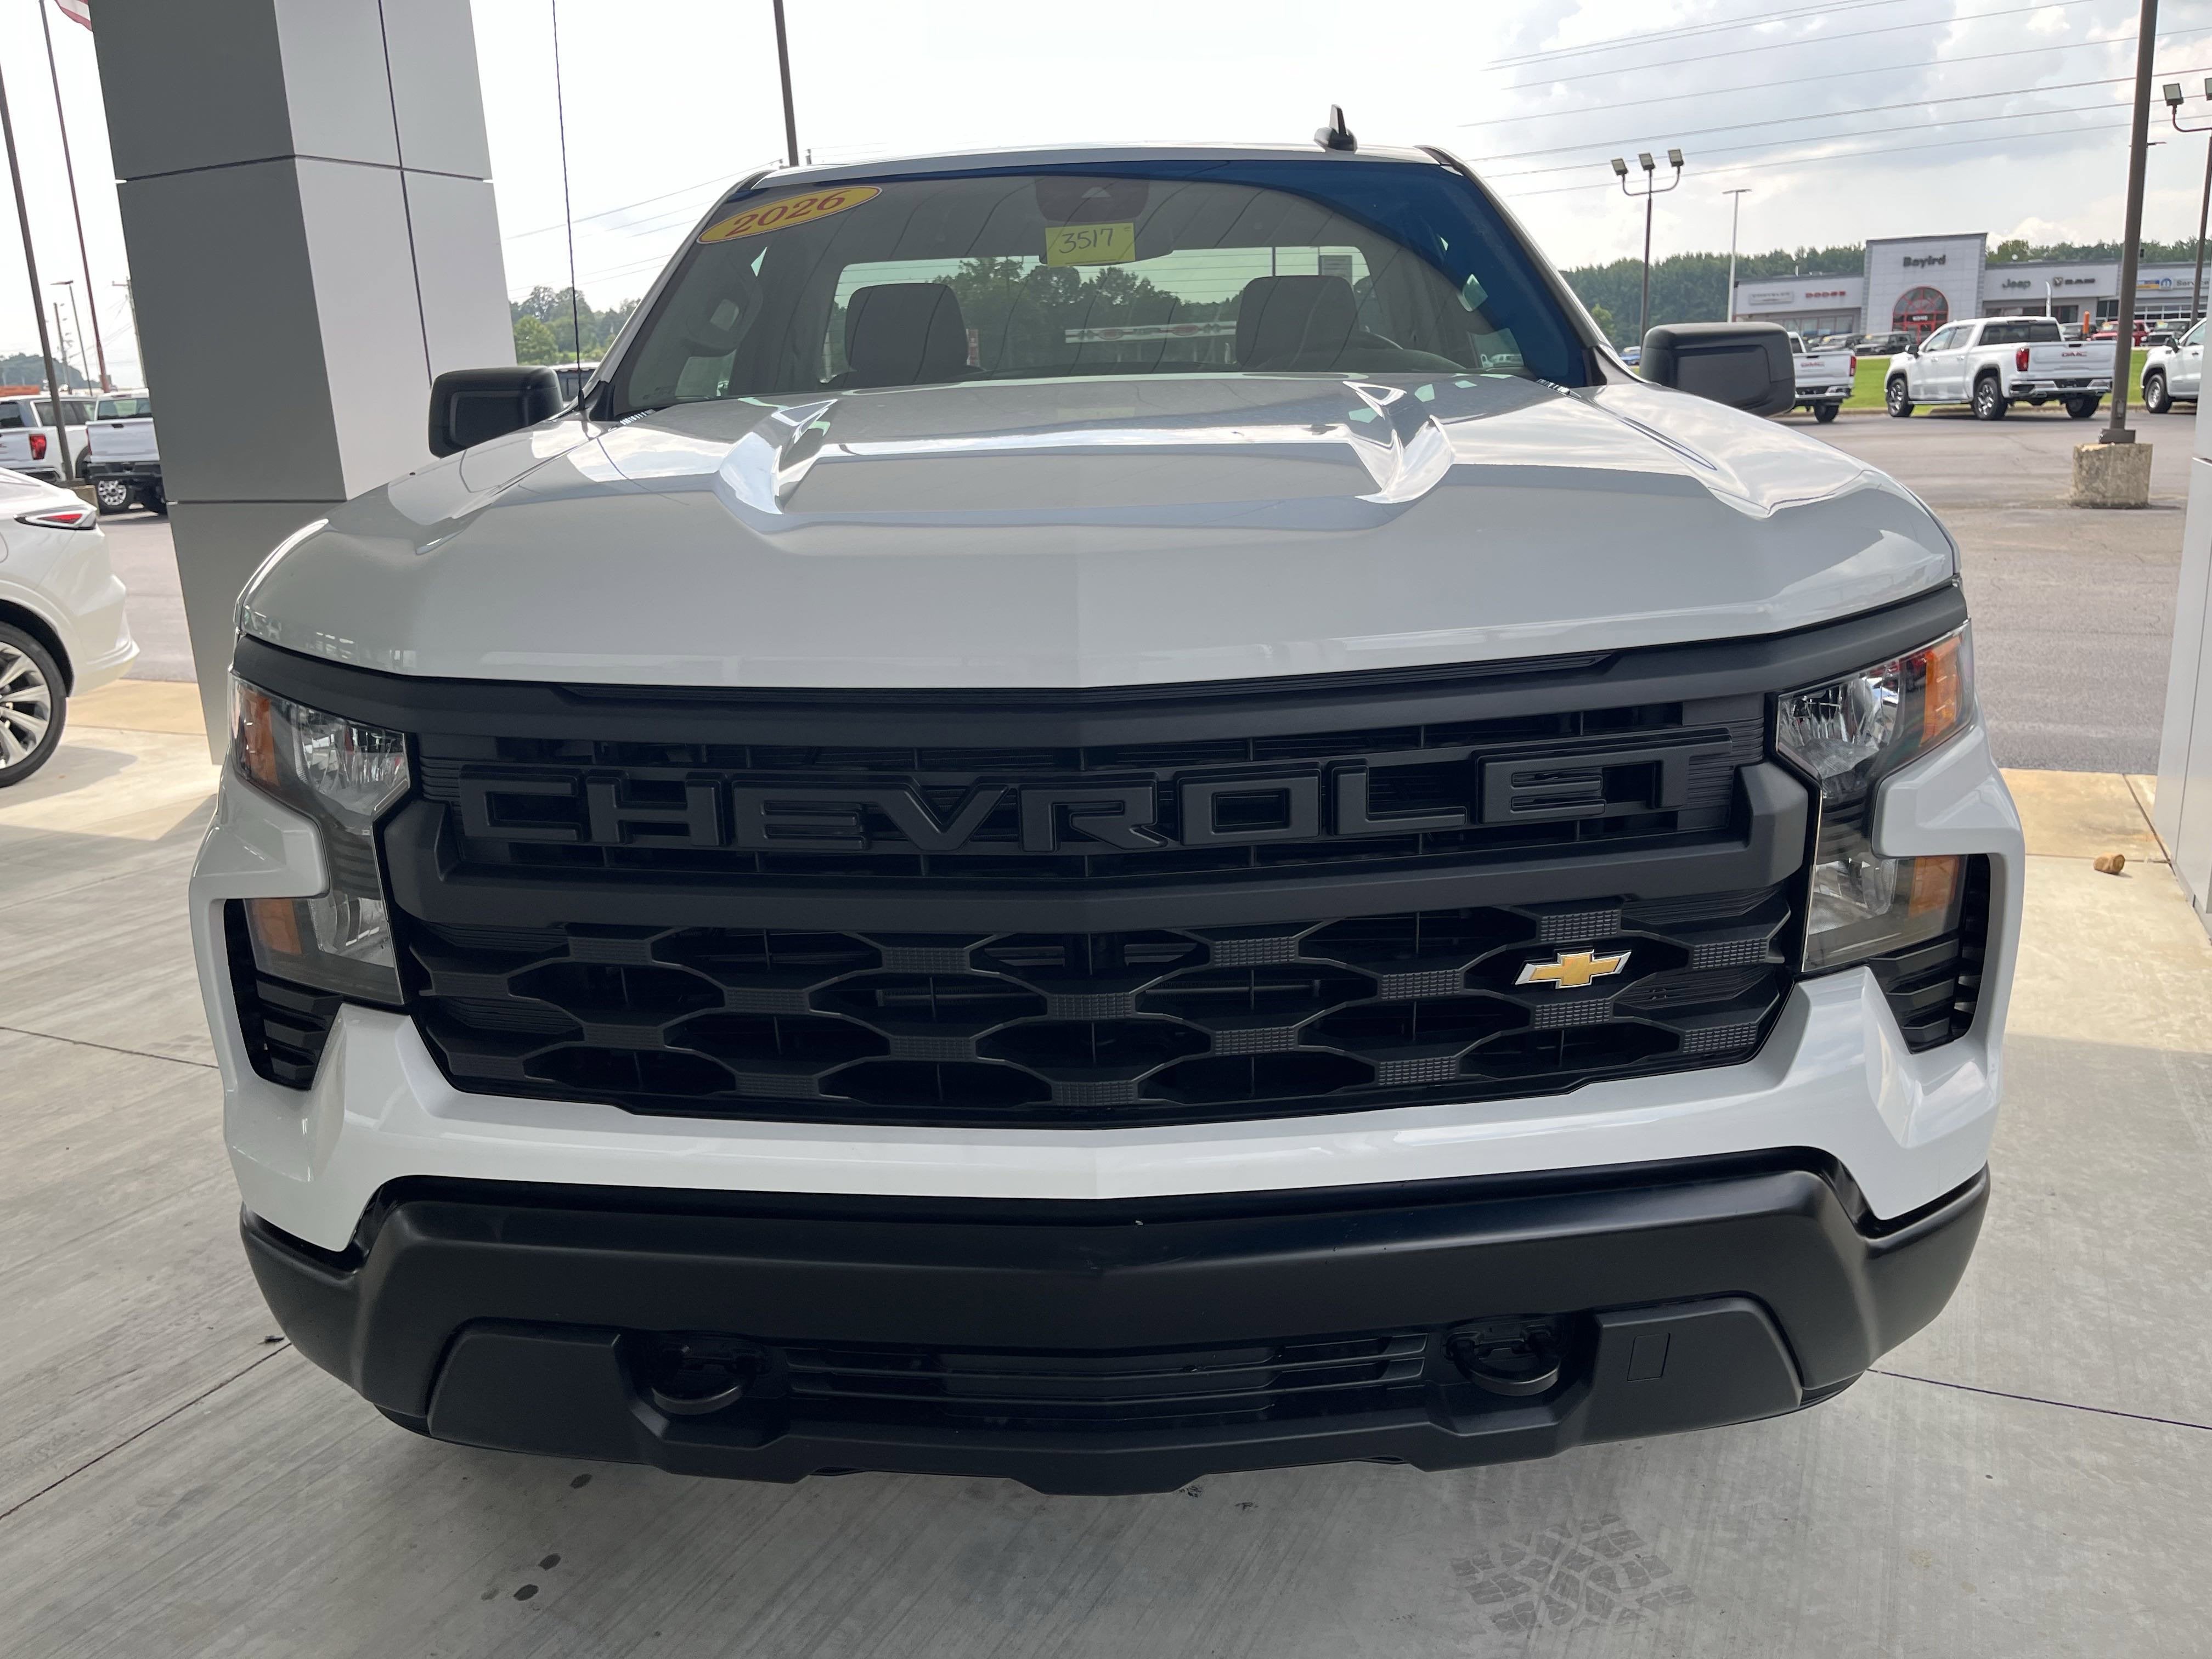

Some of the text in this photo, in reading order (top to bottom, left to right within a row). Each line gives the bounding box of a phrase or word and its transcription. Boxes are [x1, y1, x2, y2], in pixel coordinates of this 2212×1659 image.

[725, 189, 852, 237] 2026
[1059, 228, 1114, 254] 3517
[2002, 278, 2031, 290] Jeep
[459, 727, 1734, 854] CHEVROLET
